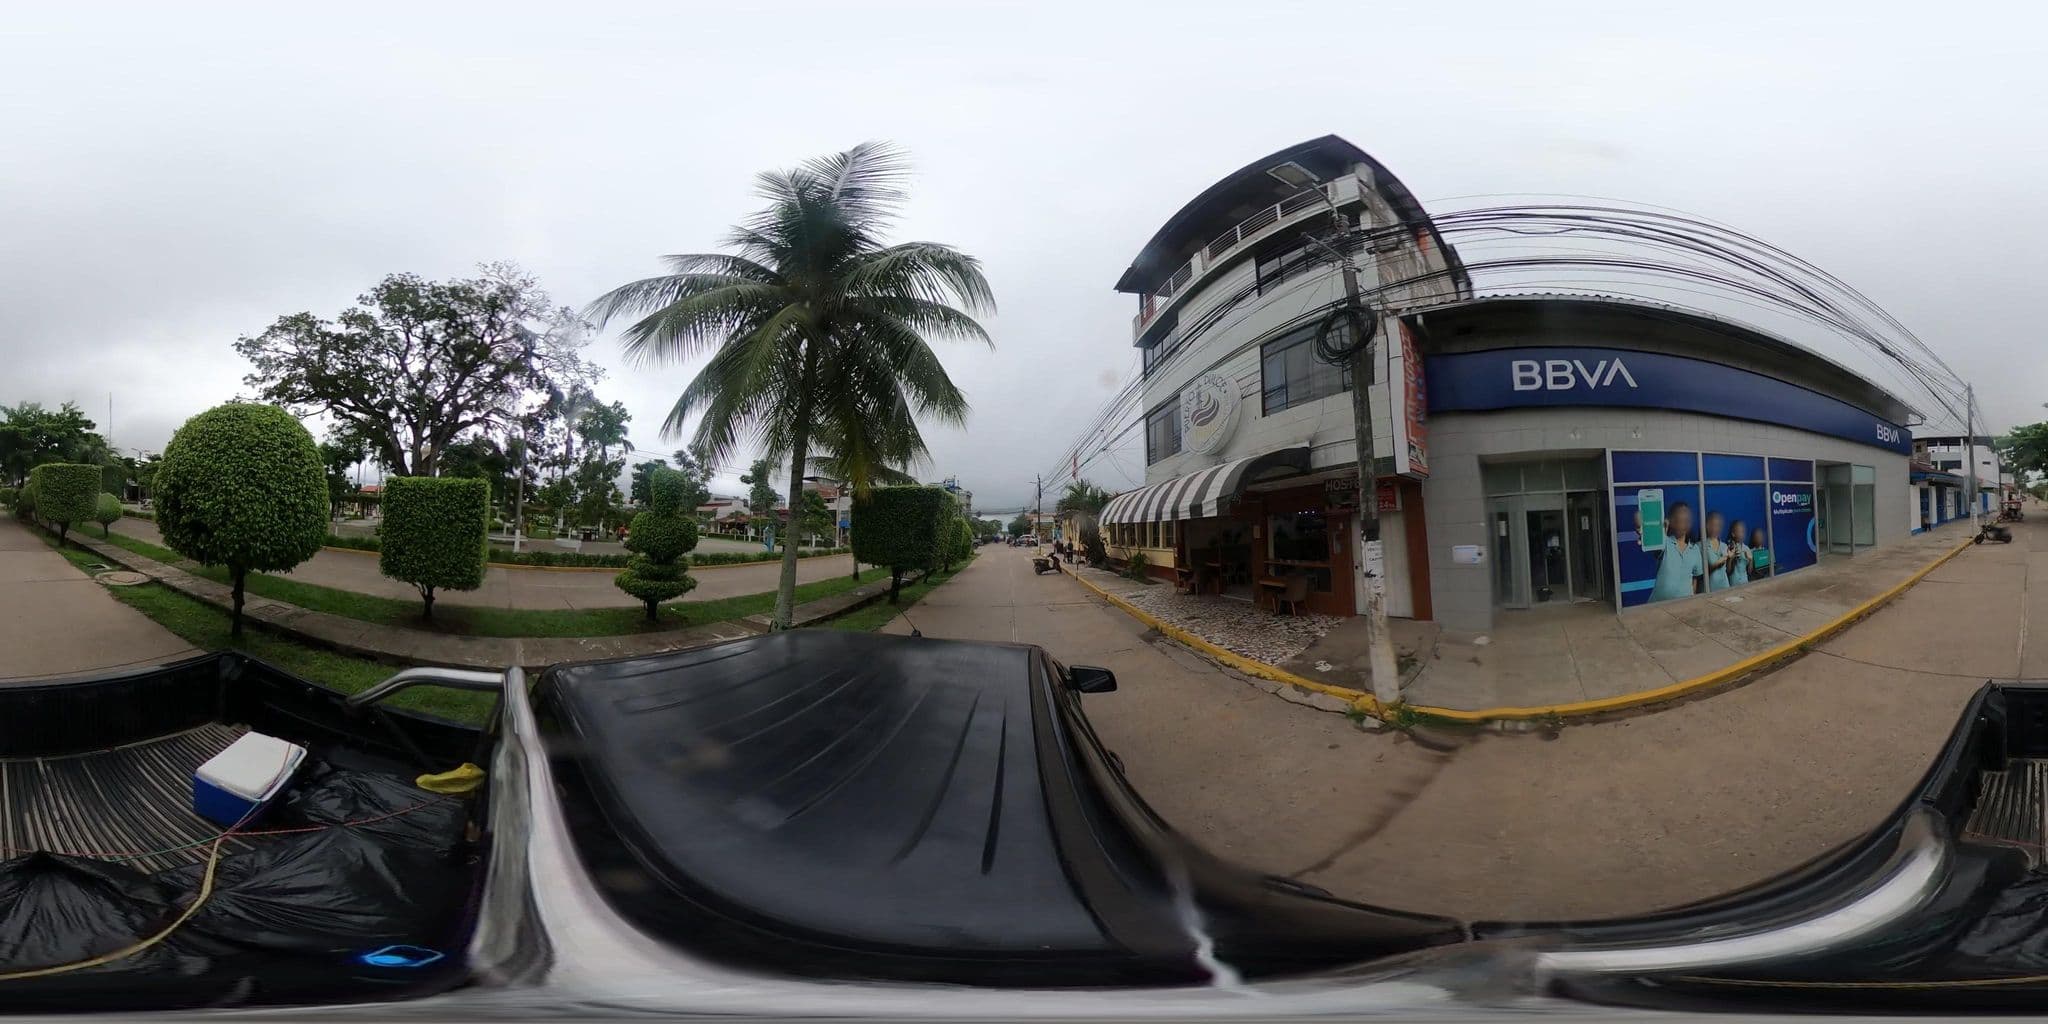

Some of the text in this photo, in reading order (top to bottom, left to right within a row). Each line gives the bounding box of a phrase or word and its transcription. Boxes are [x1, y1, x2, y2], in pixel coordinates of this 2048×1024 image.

[1512, 357, 1638, 391] BBVA
[1876, 423, 1900, 444] BBVA
[1772, 491, 1812, 506] Openpay
